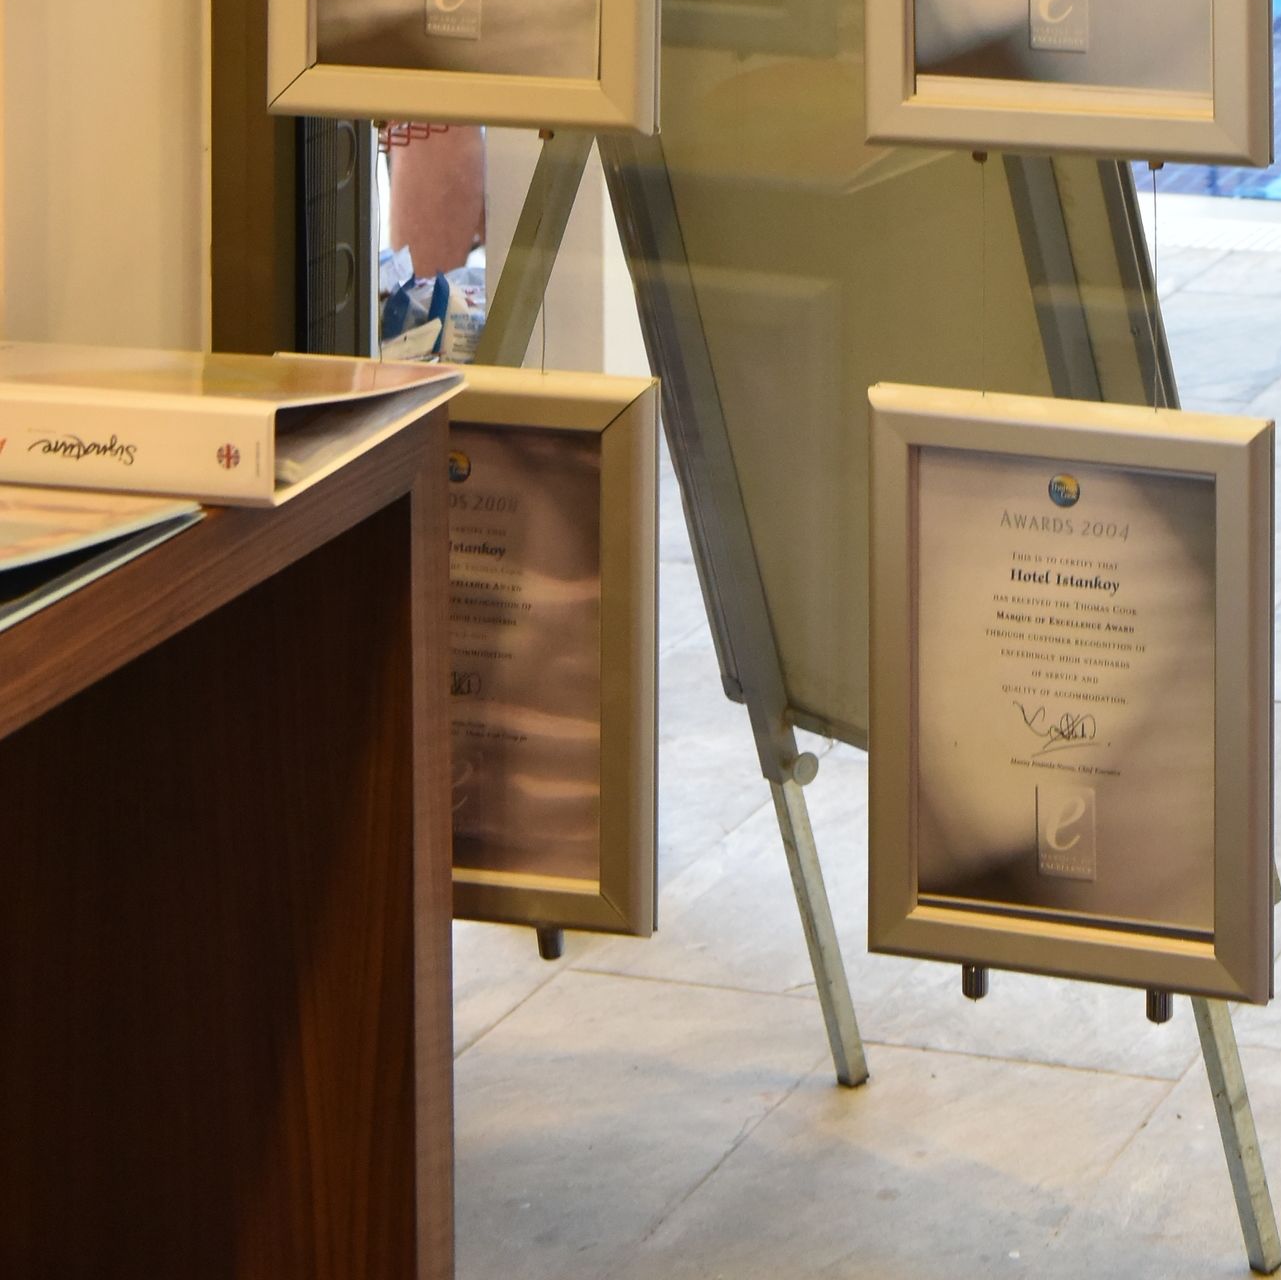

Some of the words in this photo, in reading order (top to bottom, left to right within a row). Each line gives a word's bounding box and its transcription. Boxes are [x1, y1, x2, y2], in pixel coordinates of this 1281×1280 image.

[28, 435, 137, 466] Signature
[1081, 522, 1130, 542] 2004
[1010, 568, 1050, 584] Hotel
[1056, 573, 1120, 596] Istankoy
